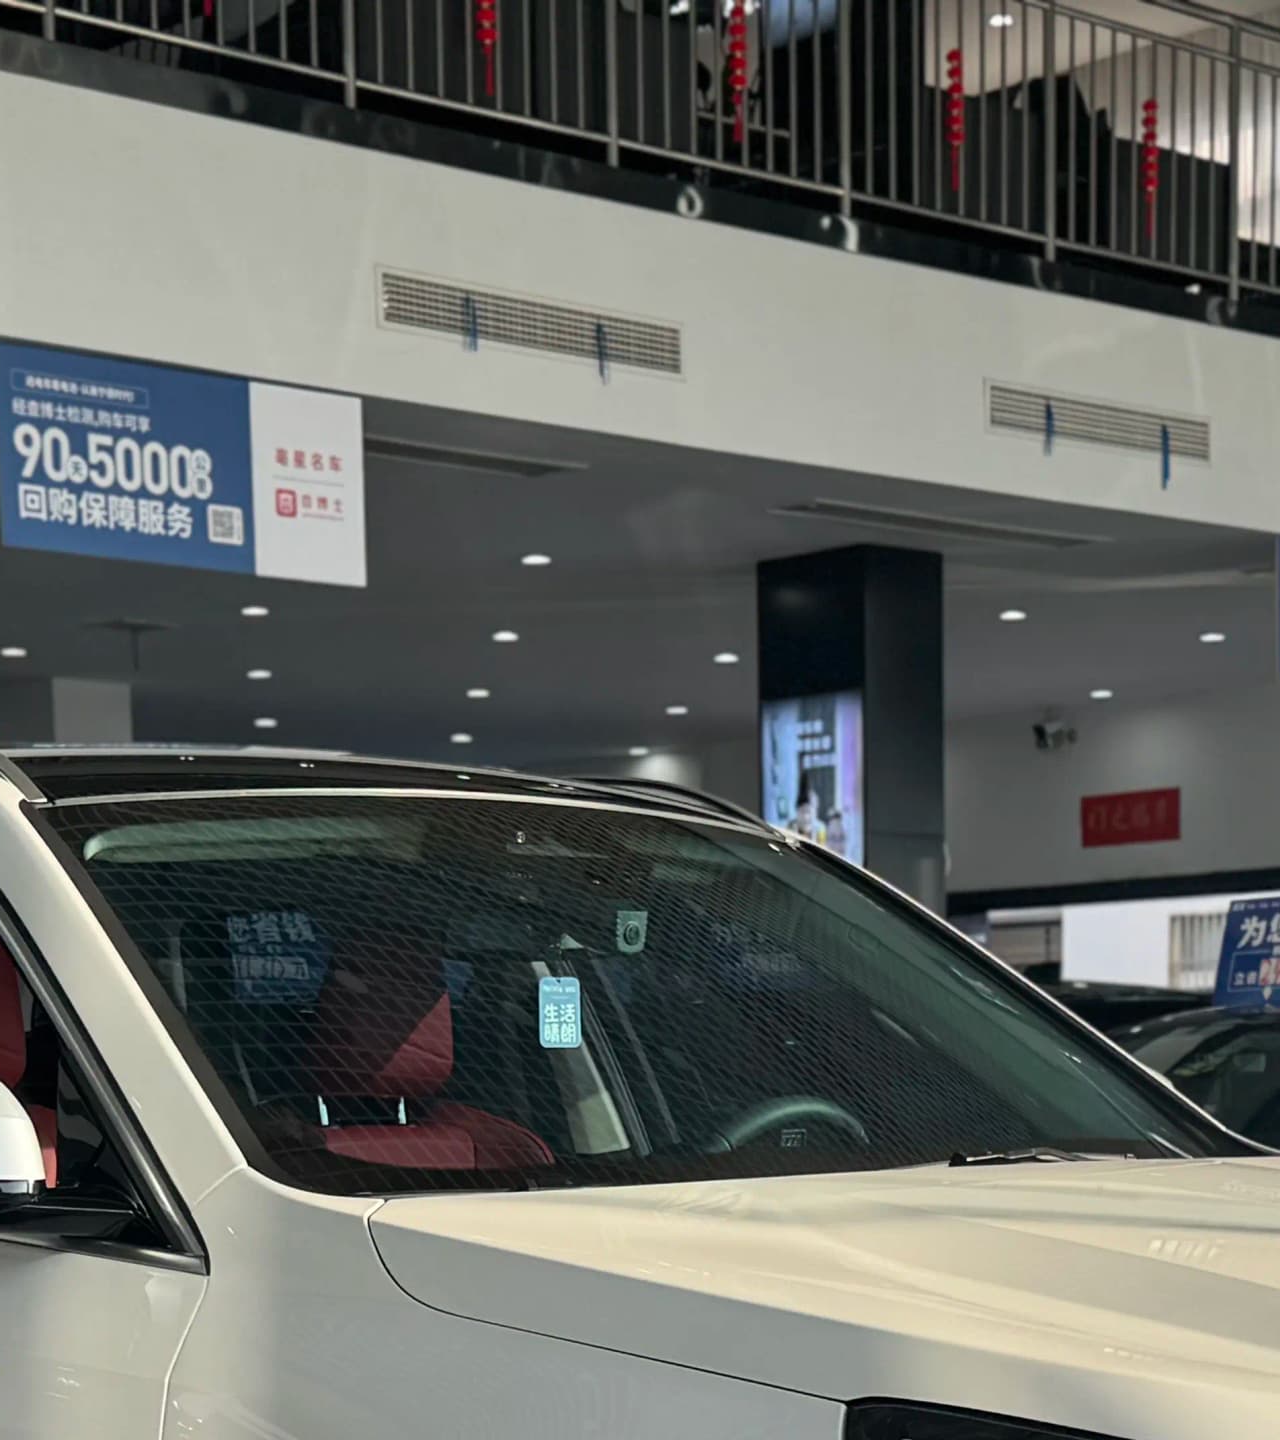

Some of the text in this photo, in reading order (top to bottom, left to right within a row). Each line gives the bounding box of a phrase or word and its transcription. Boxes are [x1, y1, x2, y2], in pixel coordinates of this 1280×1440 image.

[18, 484, 193, 540] 回购保障服务
[543, 1002, 576, 1023] 生活
